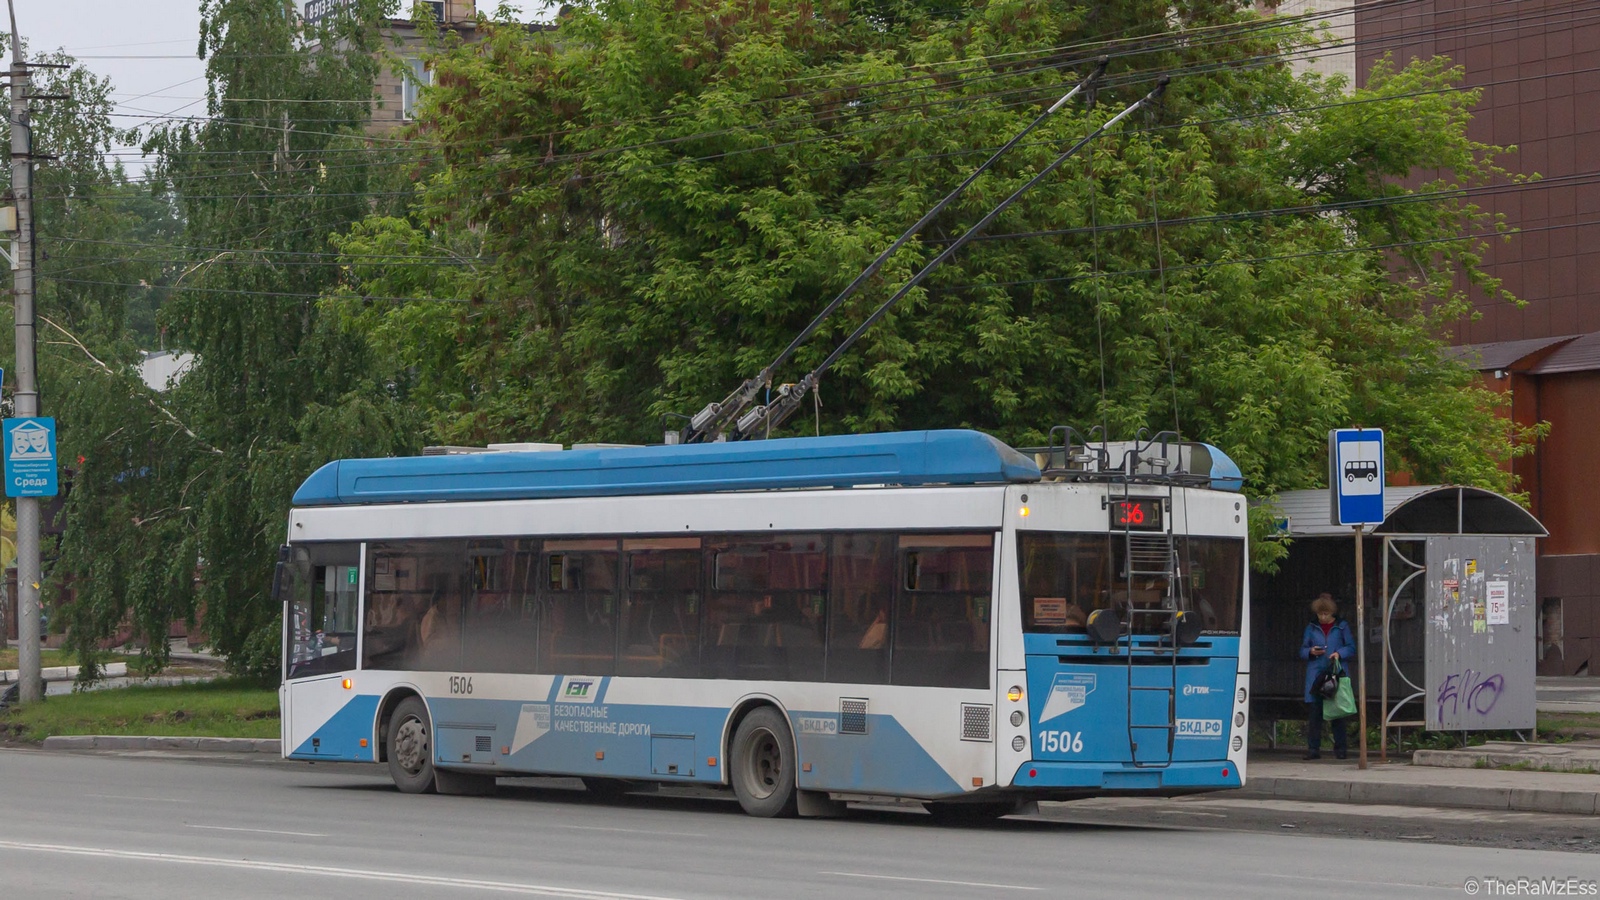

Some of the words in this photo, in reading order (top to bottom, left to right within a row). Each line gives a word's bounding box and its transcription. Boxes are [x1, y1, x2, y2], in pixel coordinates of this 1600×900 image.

[14, 477, 48, 488] Среда
[1120, 502, 1144, 524] 36
[1490, 602, 1499, 613] 75
[449, 676, 473, 695] 1506
[554, 706, 608, 719] БЕЗОПАСНЫЕ
[554, 721, 617, 735] КАЧЕСТВЕННЫЕ
[618, 723, 651, 736] ДОРОГИ
[804, 719, 836, 732] БКД.РФ
[1180, 721, 1220, 733] БКД.РФ
[1039, 730, 1083, 753] 1506
